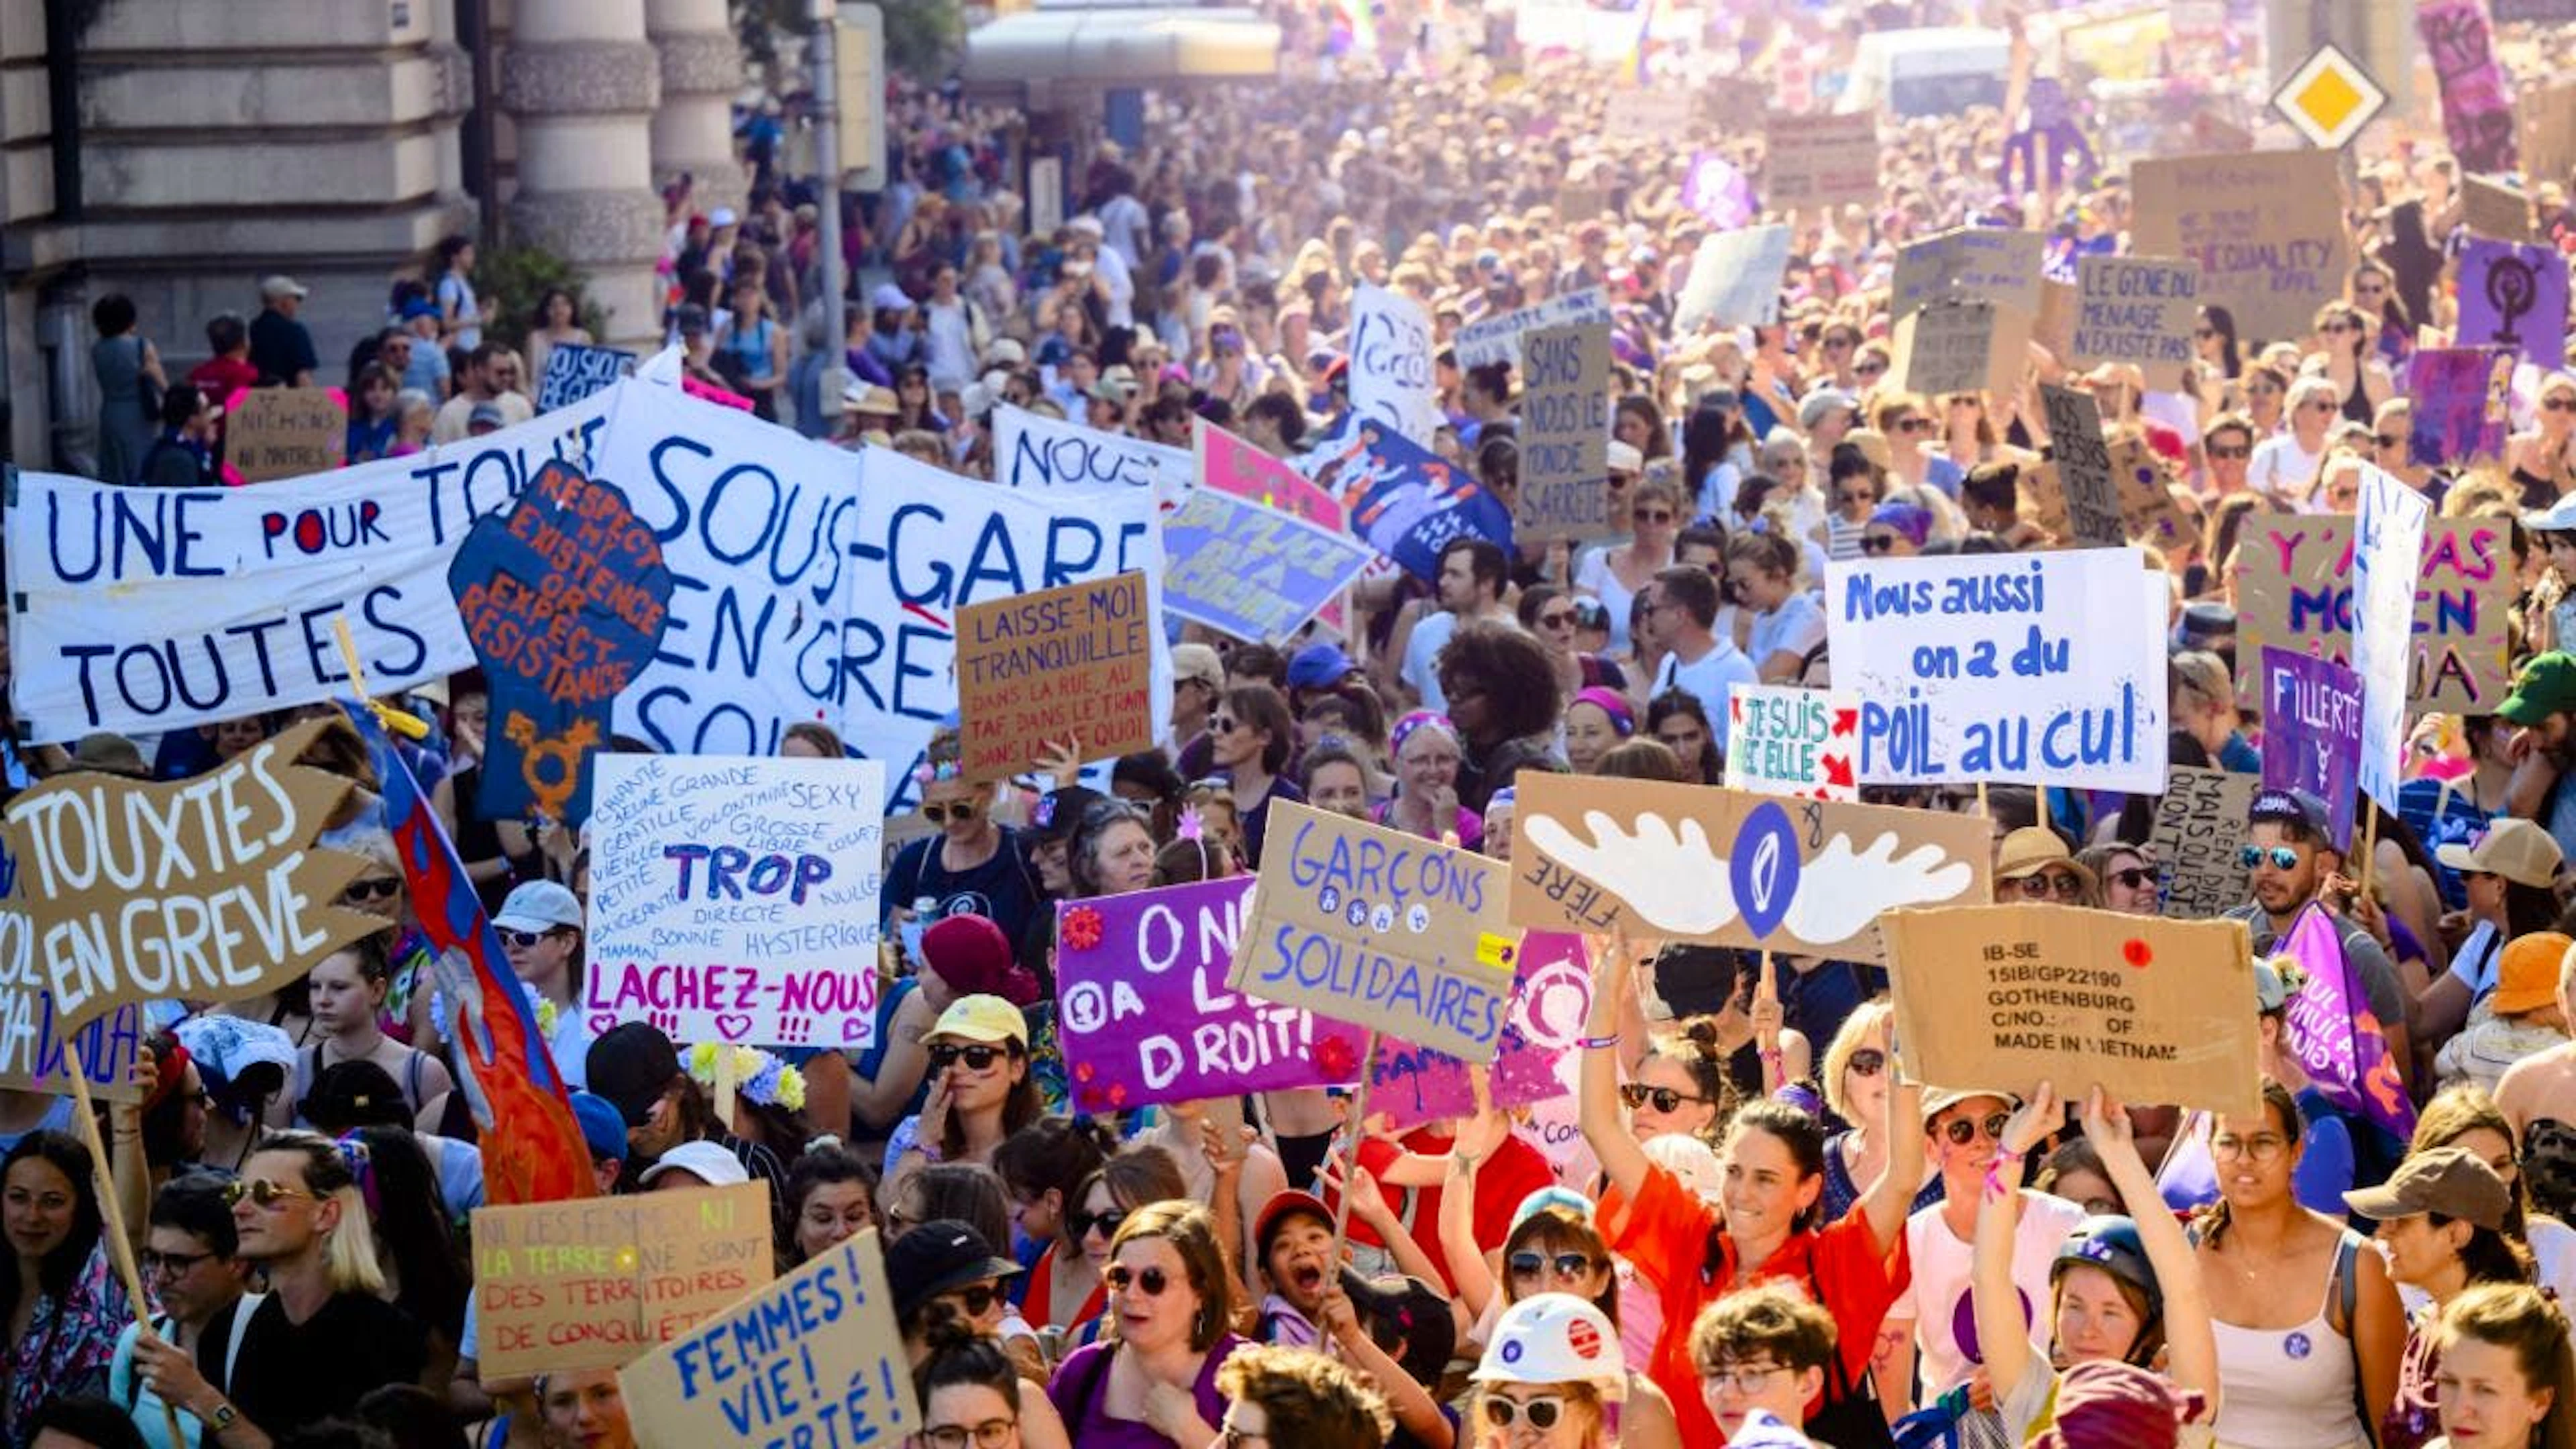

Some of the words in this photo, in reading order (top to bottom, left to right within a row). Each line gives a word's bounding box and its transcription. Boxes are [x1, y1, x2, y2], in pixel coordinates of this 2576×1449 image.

[2084, 264, 2114, 297] LE
[1527, 333, 1582, 388] SANS
[47, 490, 225, 583] UNE
[262, 498, 391, 561] POUR
[537, 467, 662, 567] RESPECT
[508, 504, 665, 636] EXISTENCE
[540, 570, 588, 611] OR
[1845, 572, 1935, 622] Nous
[1941, 559, 2044, 614] aussi
[489, 570, 617, 664] EXPECT
[976, 578, 1137, 644] LAISSE-MOI
[59, 585, 429, 728] TOUTES
[458, 582, 635, 708] RESISTANCE
[966, 621, 1144, 685] TRANQUILLE
[1913, 642, 1959, 680] on
[1966, 640, 2000, 679] a
[2010, 624, 2071, 678] du
[974, 687, 1021, 713] DANS
[1029, 679, 1054, 703] LA
[1108, 663, 1134, 686] AU
[1016, 706, 1066, 734] DANS
[1075, 698, 1097, 721] LE
[1093, 717, 1143, 747] QUOI
[1960, 713, 2030, 776] au
[2039, 682, 2137, 769] cul
[669, 764, 759, 798] GRANDE
[1764, 740, 1815, 782] ELLE
[611, 788, 664, 830] JEUNE
[788, 781, 861, 812] SEXY
[2186, 773, 2226, 839] MAIS
[5, 743, 298, 900] TOUXTES
[603, 804, 696, 858] GENTILLE
[729, 812, 833, 839] GROSSE
[745, 836, 806, 855] LIBRE
[596, 863, 657, 915] PETITE
[663, 843, 833, 906] TROP
[820, 872, 881, 907] NULLE
[1290, 820, 1489, 918] GARÇONS
[44, 910, 117, 1017] EN
[121, 851, 329, 995] GREVE
[692, 903, 785, 925] DIRECTE
[597, 941, 659, 962] MAMAN
[650, 926, 724, 948] BONNE
[1982, 942, 2040, 961] IB-SE
[588, 963, 877, 1014] LACHEZ-NOUS
[1987, 988, 2136, 1012] GOTHENBURG
[1994, 1033, 2055, 1051] MADE
[2061, 1036, 2081, 1053] IN
[2106, 1018, 2133, 1035] OF
[478, 1216, 509, 1243] NI
[523, 1212, 574, 1243] LES
[699, 1199, 735, 1234] NI
[481, 1248, 513, 1279] LA
[524, 1244, 612, 1274] TERRE
[641, 1244, 678, 1272] NE
[696, 1236, 765, 1267] SONT
[482, 1283, 545, 1313] DES
[560, 1268, 747, 1307] TERRITOIRES
[494, 1324, 538, 1353] DE
